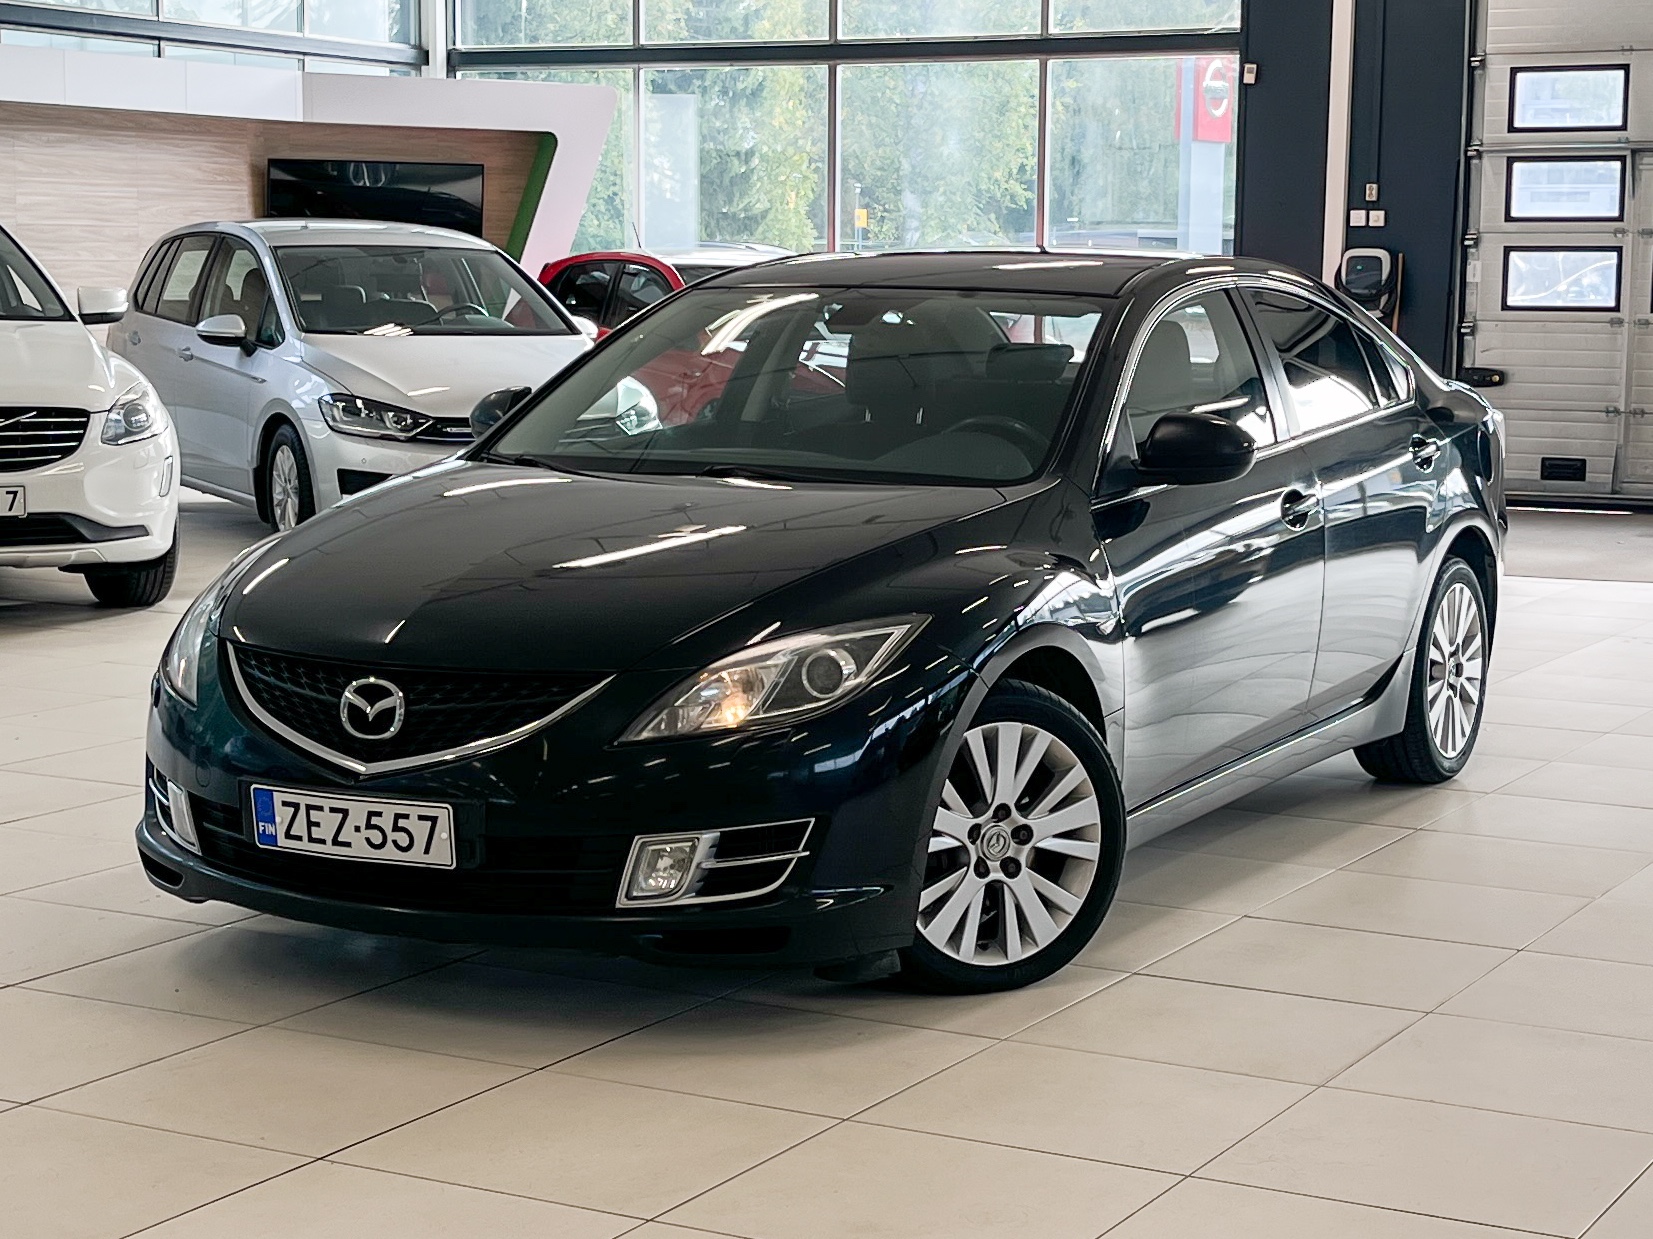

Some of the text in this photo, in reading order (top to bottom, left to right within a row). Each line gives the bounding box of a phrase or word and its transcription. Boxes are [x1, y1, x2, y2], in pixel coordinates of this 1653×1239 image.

[5, 490, 19, 512] 7
[258, 822, 276, 836] FIN
[281, 800, 439, 855] ZEZ-557
